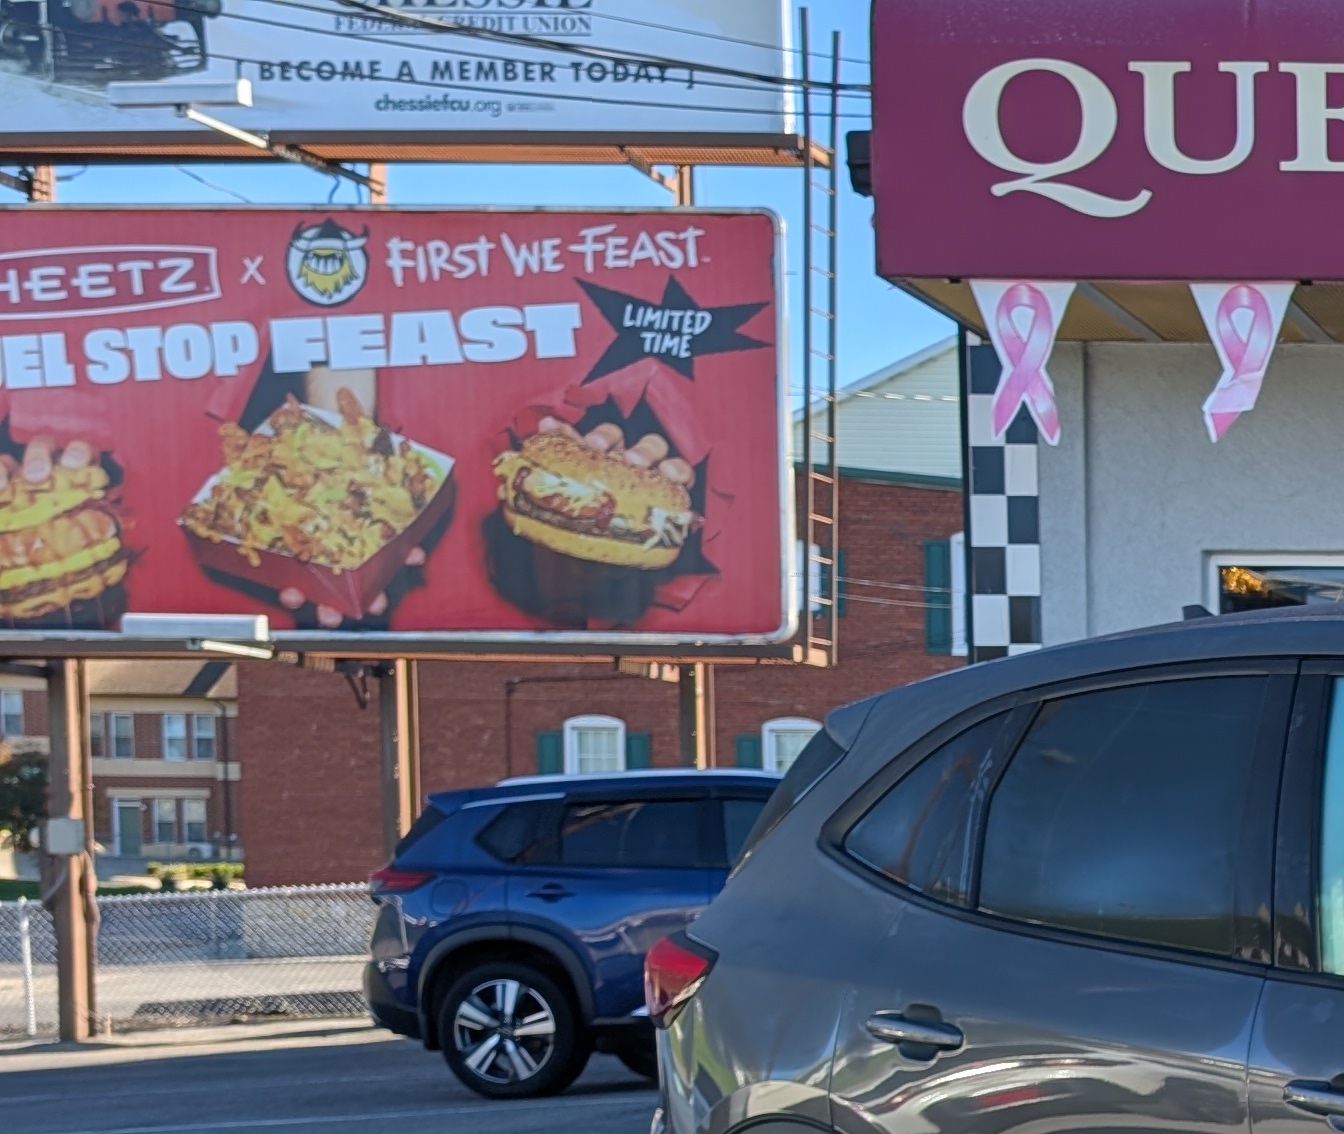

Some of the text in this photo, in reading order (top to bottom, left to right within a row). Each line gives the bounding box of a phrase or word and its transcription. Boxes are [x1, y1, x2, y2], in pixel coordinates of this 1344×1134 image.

[521, 15, 592, 32] UNION
[259, 60, 668, 83] BECOME A MEMBER TODAY
[374, 93, 502, 118] chessiefcu.org
[385, 224, 706, 288] FIRST WE FEAST
[622, 303, 713, 334] LIMITED
[0, 301, 583, 391] EL STOP FEAST
[640, 331, 694, 358] TIME
